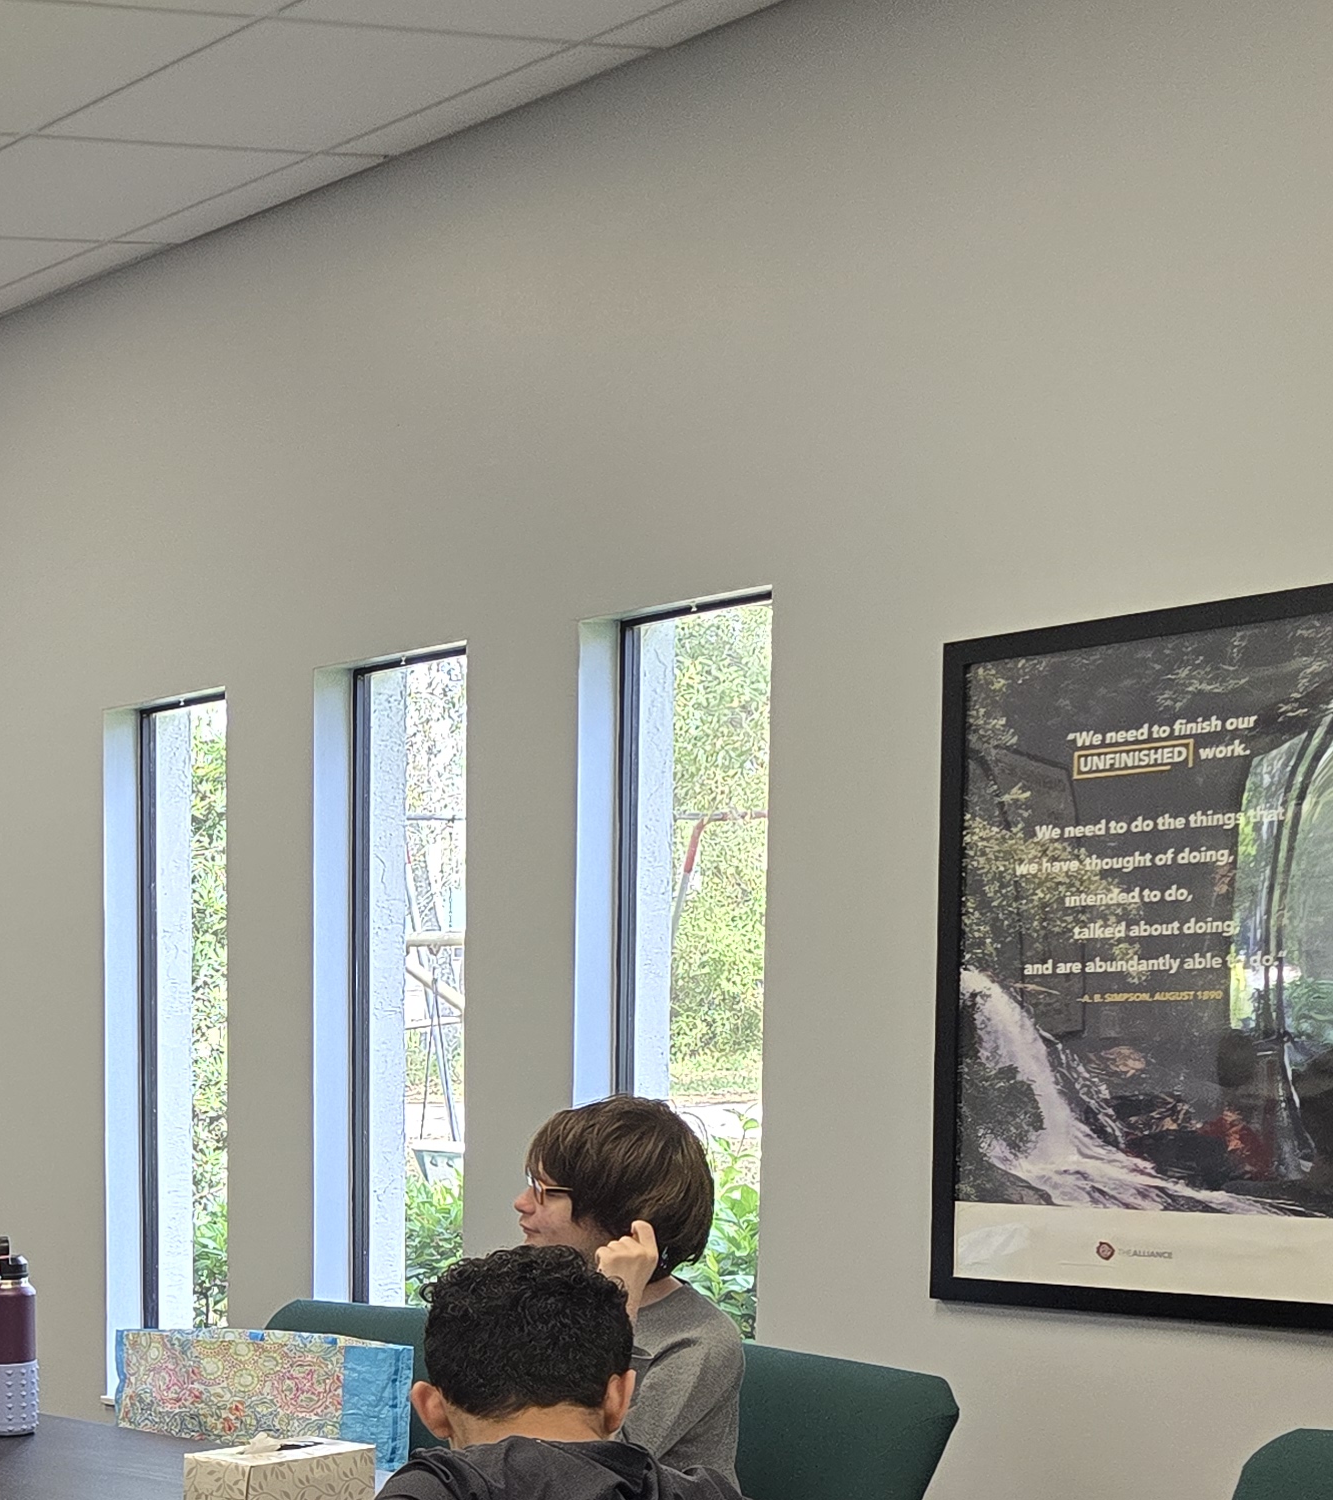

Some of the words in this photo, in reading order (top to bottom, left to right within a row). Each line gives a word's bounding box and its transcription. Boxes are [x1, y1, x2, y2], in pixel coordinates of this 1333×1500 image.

[1106, 725, 1148, 743] need
[1152, 725, 1170, 738] to
[1172, 716, 1221, 735] finish
[1226, 715, 1257, 730] our
[1080, 746, 1187, 772] UNFINISHED
[1199, 740, 1250, 760] work.
[1035, 825, 1060, 841] We
[1064, 820, 1106, 838] need
[1109, 820, 1127, 835] to
[1131, 817, 1153, 832] do
[1158, 814, 1185, 830] the
[1189, 810, 1244, 829] things
[1248, 806, 1284, 821] that
[1042, 857, 1079, 873] have
[1085, 852, 1152, 872] thought
[1155, 848, 1174, 865] of
[1178, 848, 1234, 867] doing,
[1065, 887, 1140, 907] intended
[1143, 888, 1160, 902] to
[1165, 884, 1192, 901] do,
[1074, 921, 1126, 940] talked
[1130, 921, 1180, 935] about
[1183, 918, 1240, 937] doing,
[1024, 959, 1053, 975] and
[1056, 962, 1082, 973] are
[1085, 954, 1180, 973] abundantly
[1184, 953, 1222, 969] able
[1154, 991, 1194, 1000] AUGUST
[1197, 990, 1223, 1000] 1890
